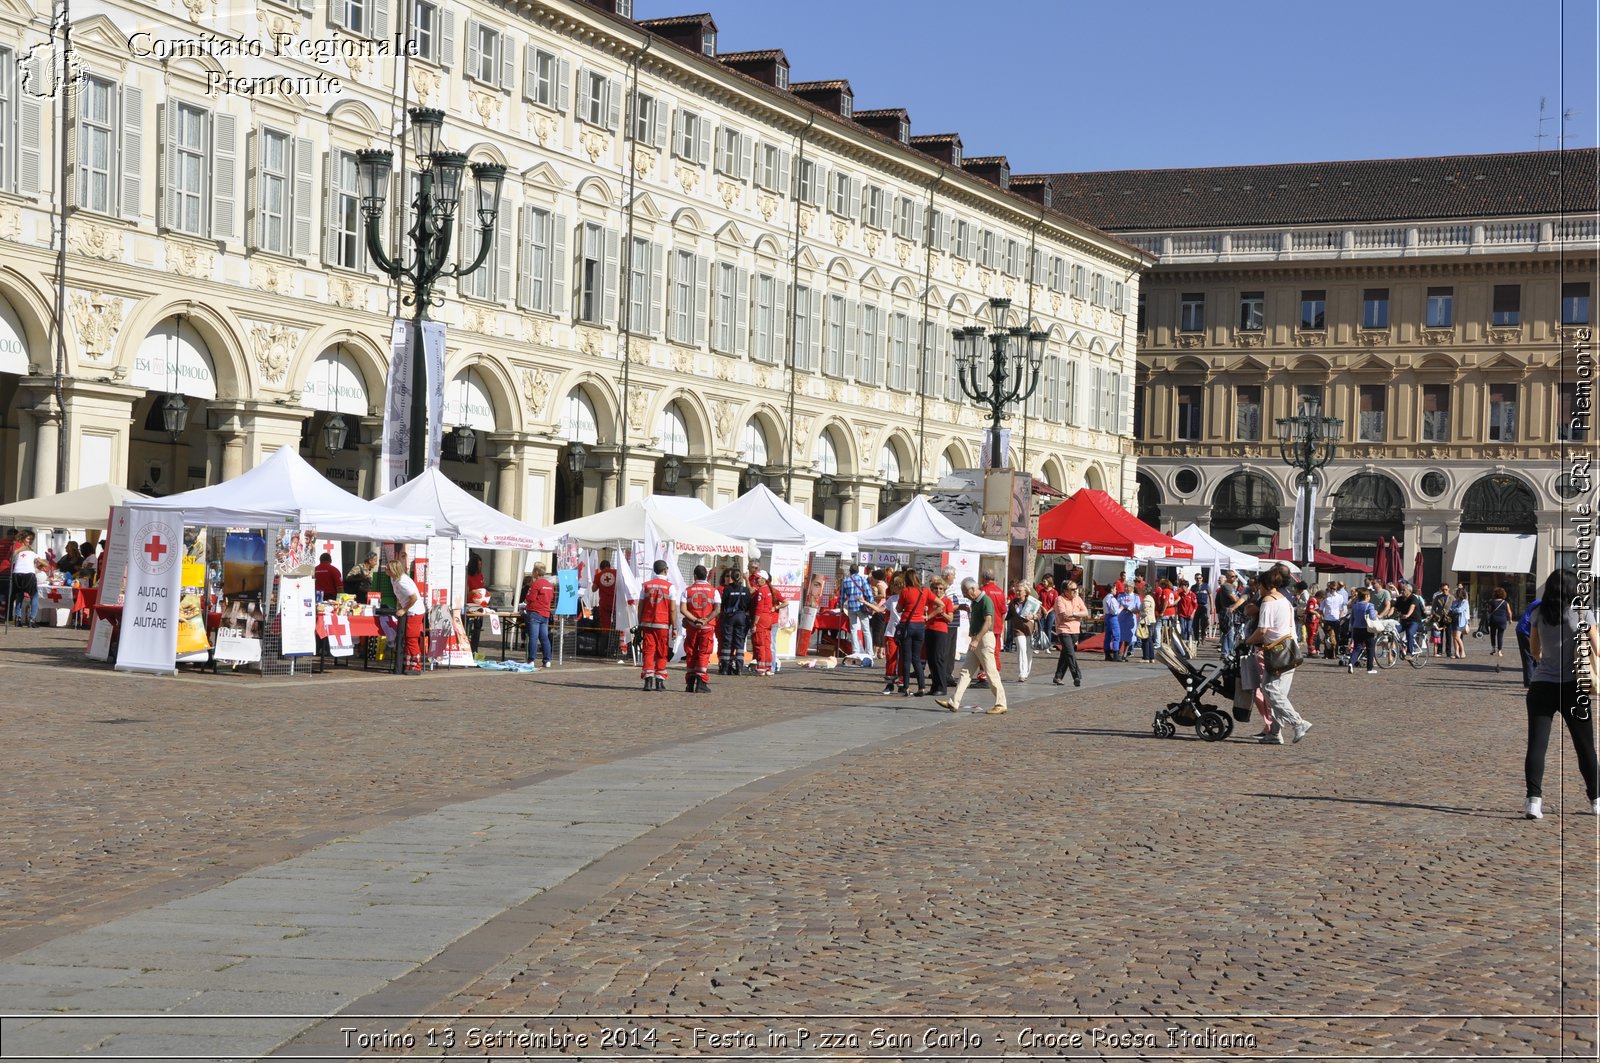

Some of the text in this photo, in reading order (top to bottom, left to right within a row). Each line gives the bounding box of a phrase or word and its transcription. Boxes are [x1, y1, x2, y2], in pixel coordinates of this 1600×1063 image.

[166, 361, 209, 381] SANPAOLO
[328, 384, 363, 400] SANPAOLO
[675, 541, 744, 554] CROCE ROSSA ITALIANA
[1042, 538, 1057, 551] CRT
[137, 586, 168, 598] AIUTACI
[145, 602, 158, 613] AD
[133, 617, 167, 629] AIUTARE
[218, 627, 243, 638] HOPE
